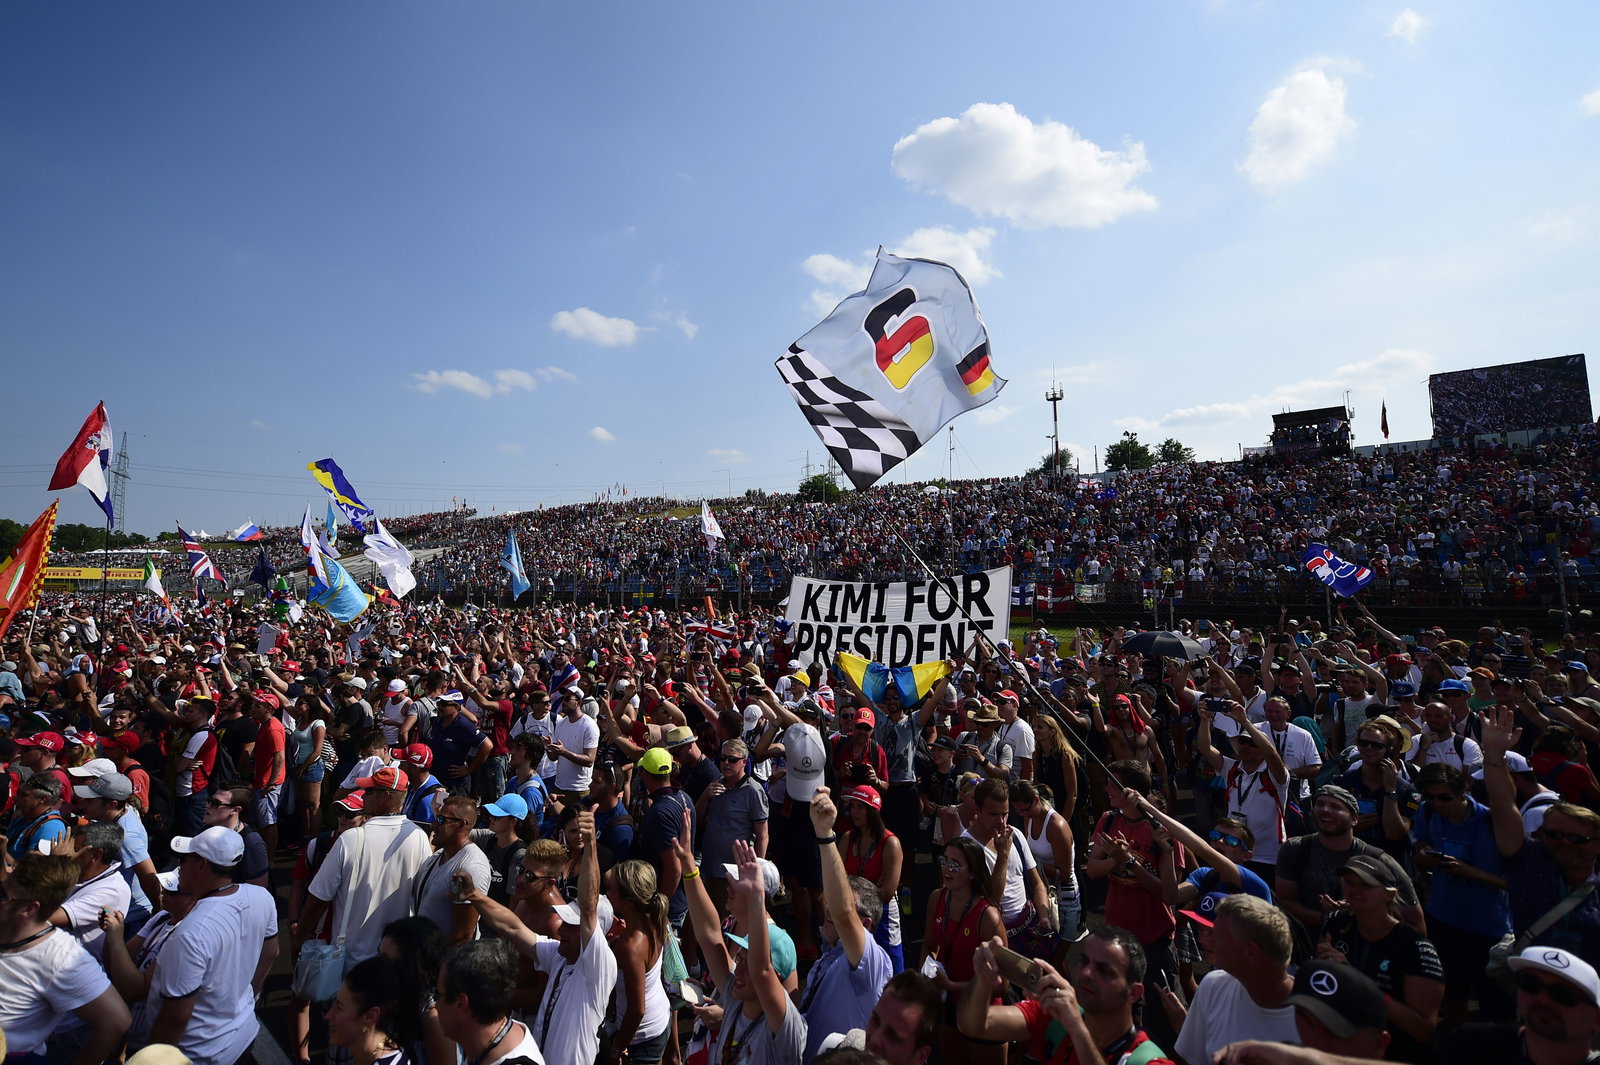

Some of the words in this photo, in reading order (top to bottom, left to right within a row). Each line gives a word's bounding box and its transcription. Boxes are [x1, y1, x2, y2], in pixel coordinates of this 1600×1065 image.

[46, 569, 82, 577] IRELLI
[801, 584, 889, 623] KIMI
[904, 573, 994, 622] FOR
